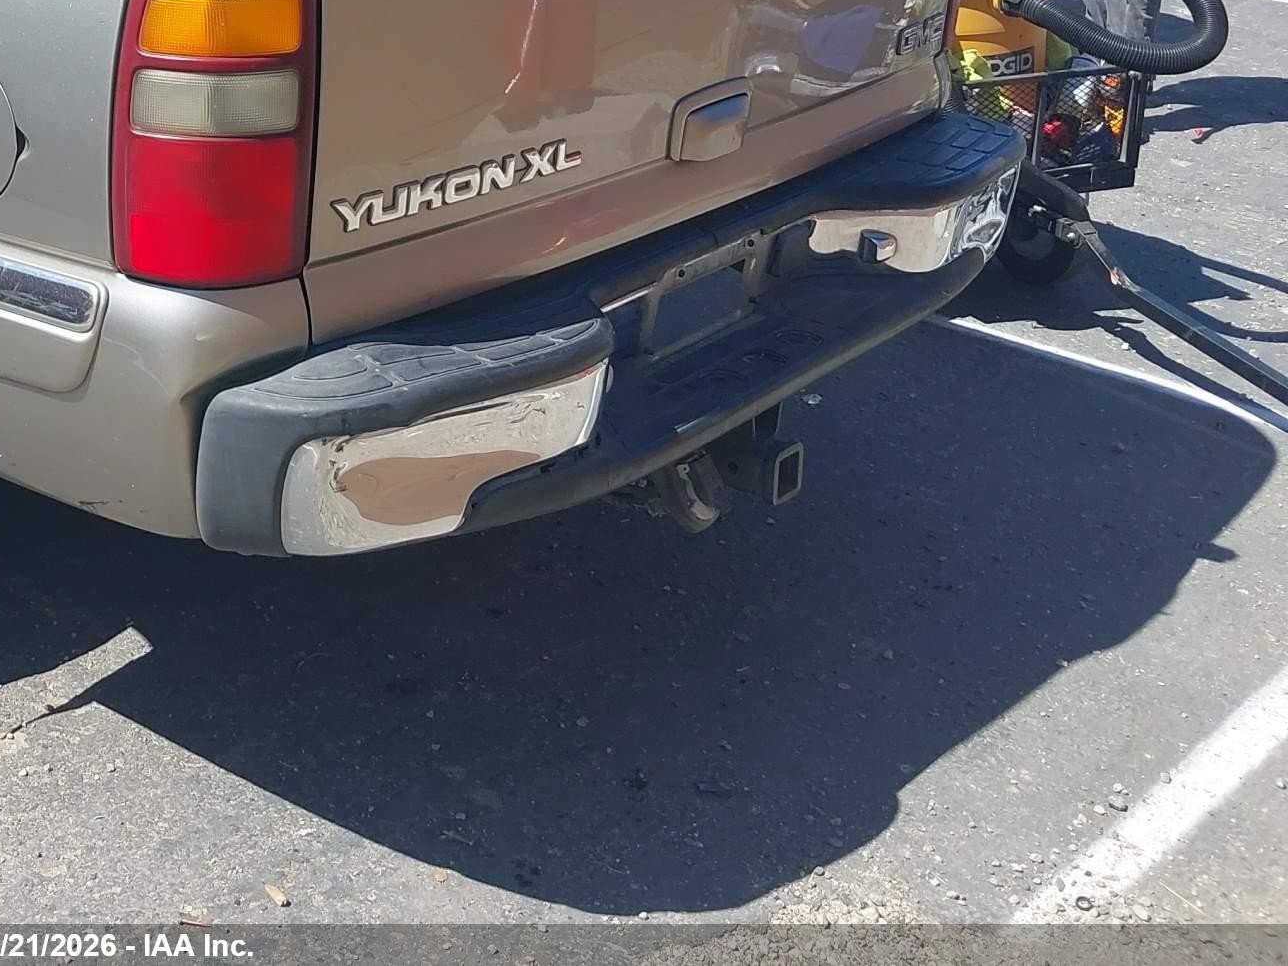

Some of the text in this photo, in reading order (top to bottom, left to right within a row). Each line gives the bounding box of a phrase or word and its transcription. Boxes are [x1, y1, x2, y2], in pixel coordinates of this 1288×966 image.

[899, 13, 945, 54] GMC
[990, 51, 1033, 77] DGID
[330, 138, 582, 233] YUKON XL
